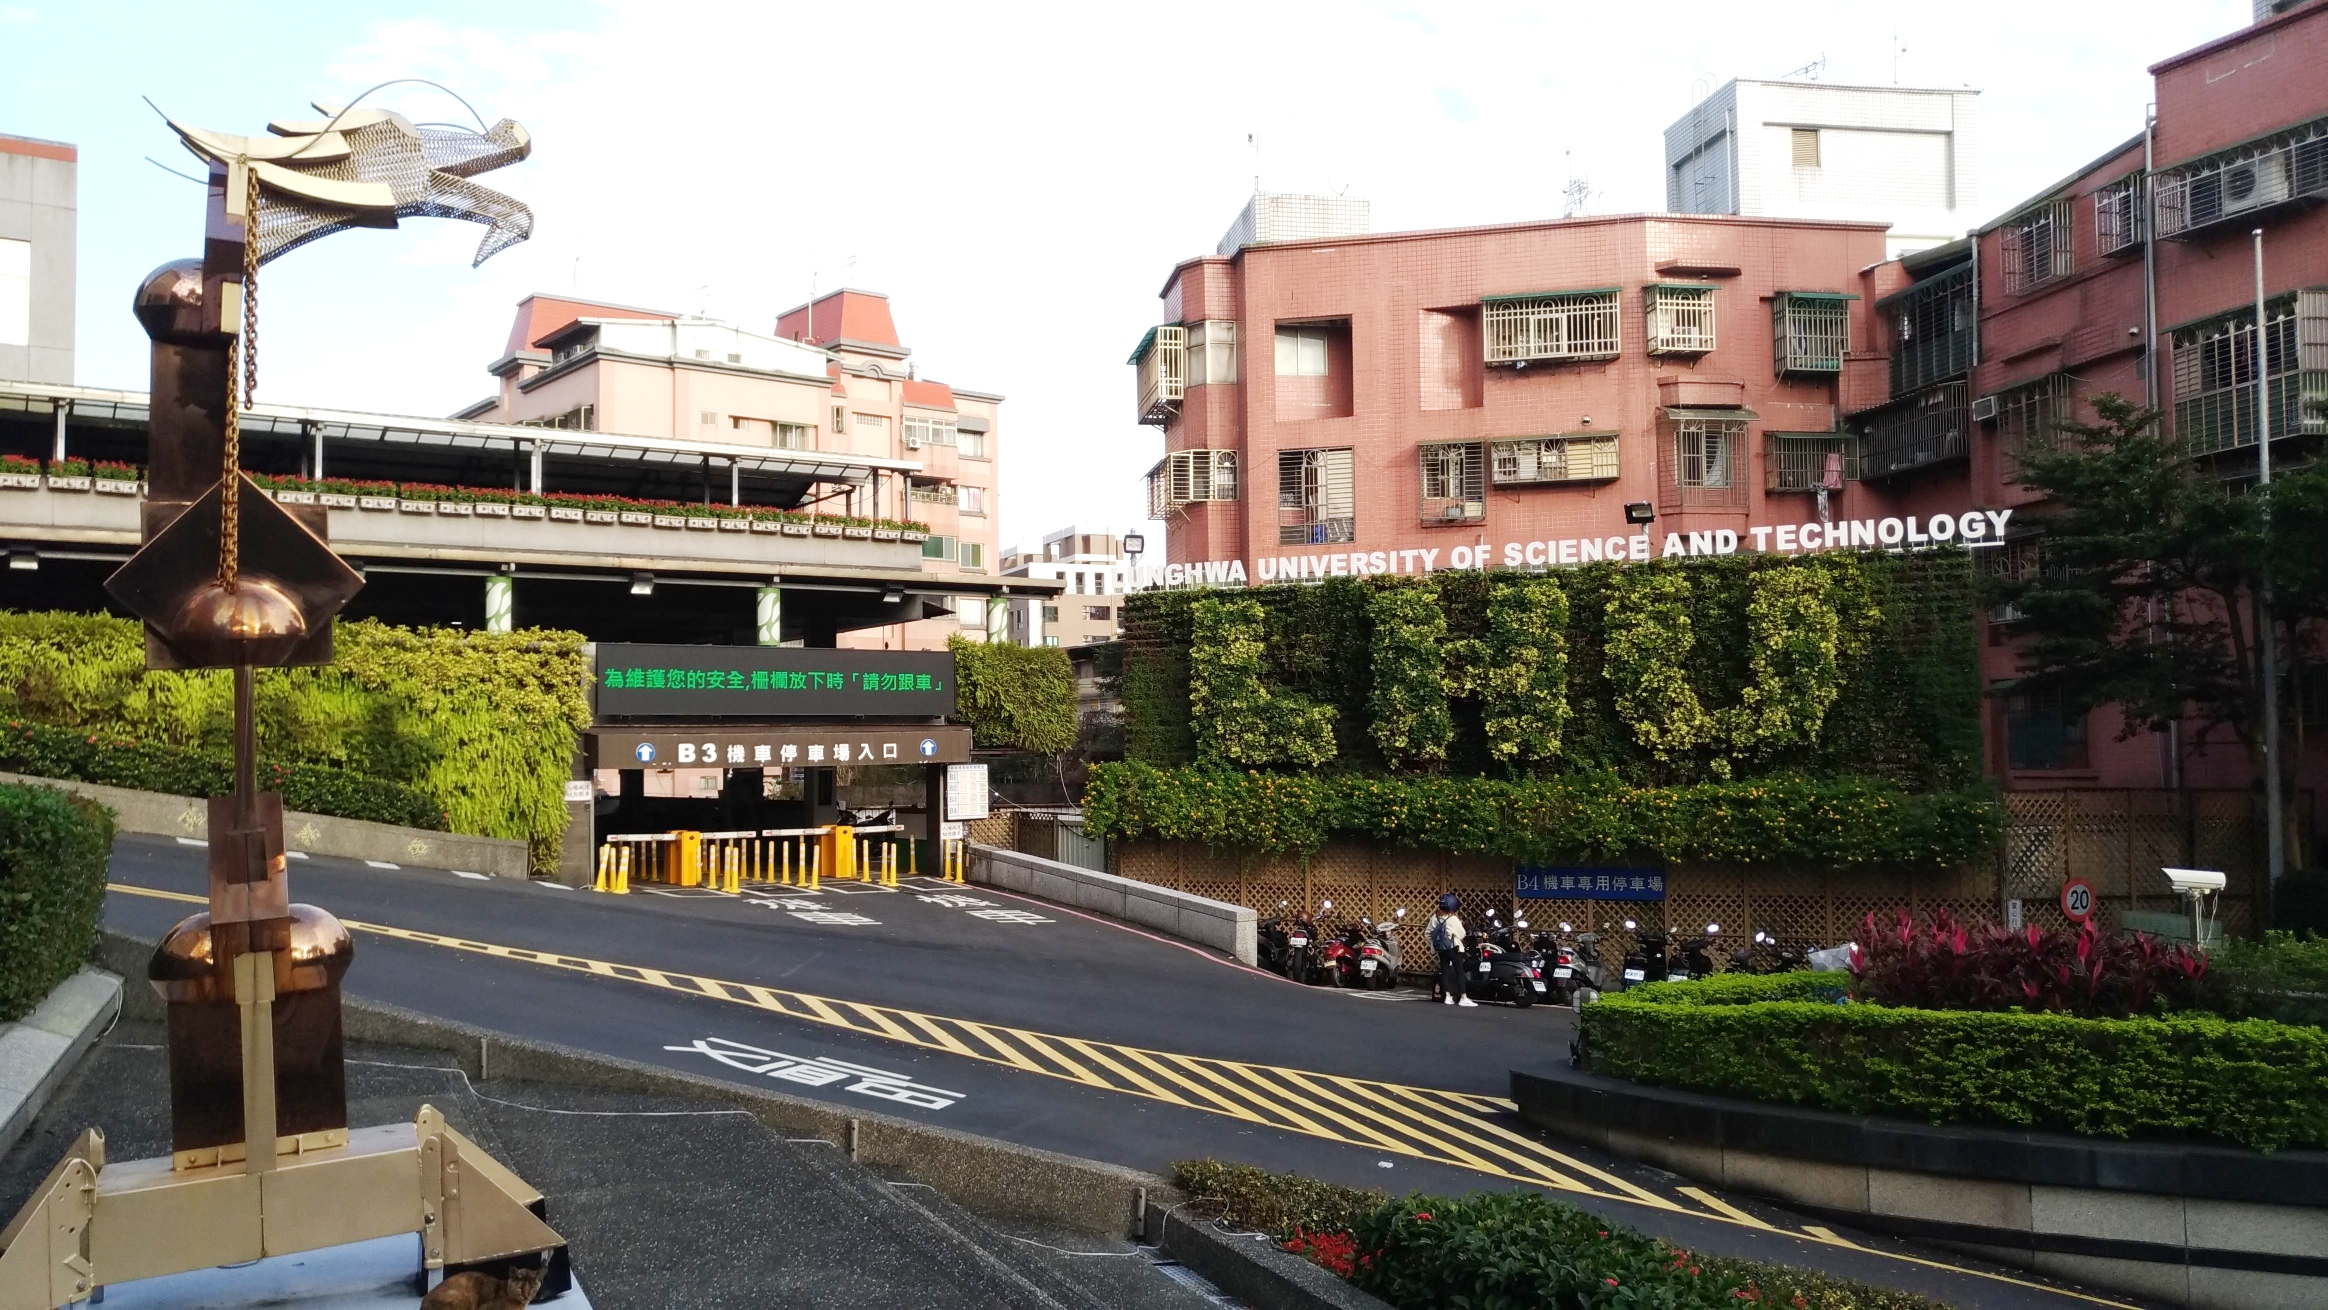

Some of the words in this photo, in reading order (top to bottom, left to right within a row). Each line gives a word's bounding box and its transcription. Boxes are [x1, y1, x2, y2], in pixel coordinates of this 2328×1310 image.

[1111, 560, 1247, 589] LUNGHWA
[1258, 548, 1439, 580] UNIVERSITY
[1451, 544, 1491, 571] OF
[1504, 534, 1648, 567] SCIENCE
[1663, 529, 1738, 558] AND
[1750, 509, 2013, 553] TECHNOLOGY
[678, 743, 718, 763] B3
[727, 743, 898, 763] 機車停車場入口
[1517, 874, 1539, 891] B4
[1544, 875, 1664, 892] 機車專用停車場
[2070, 889, 2090, 911] 20
